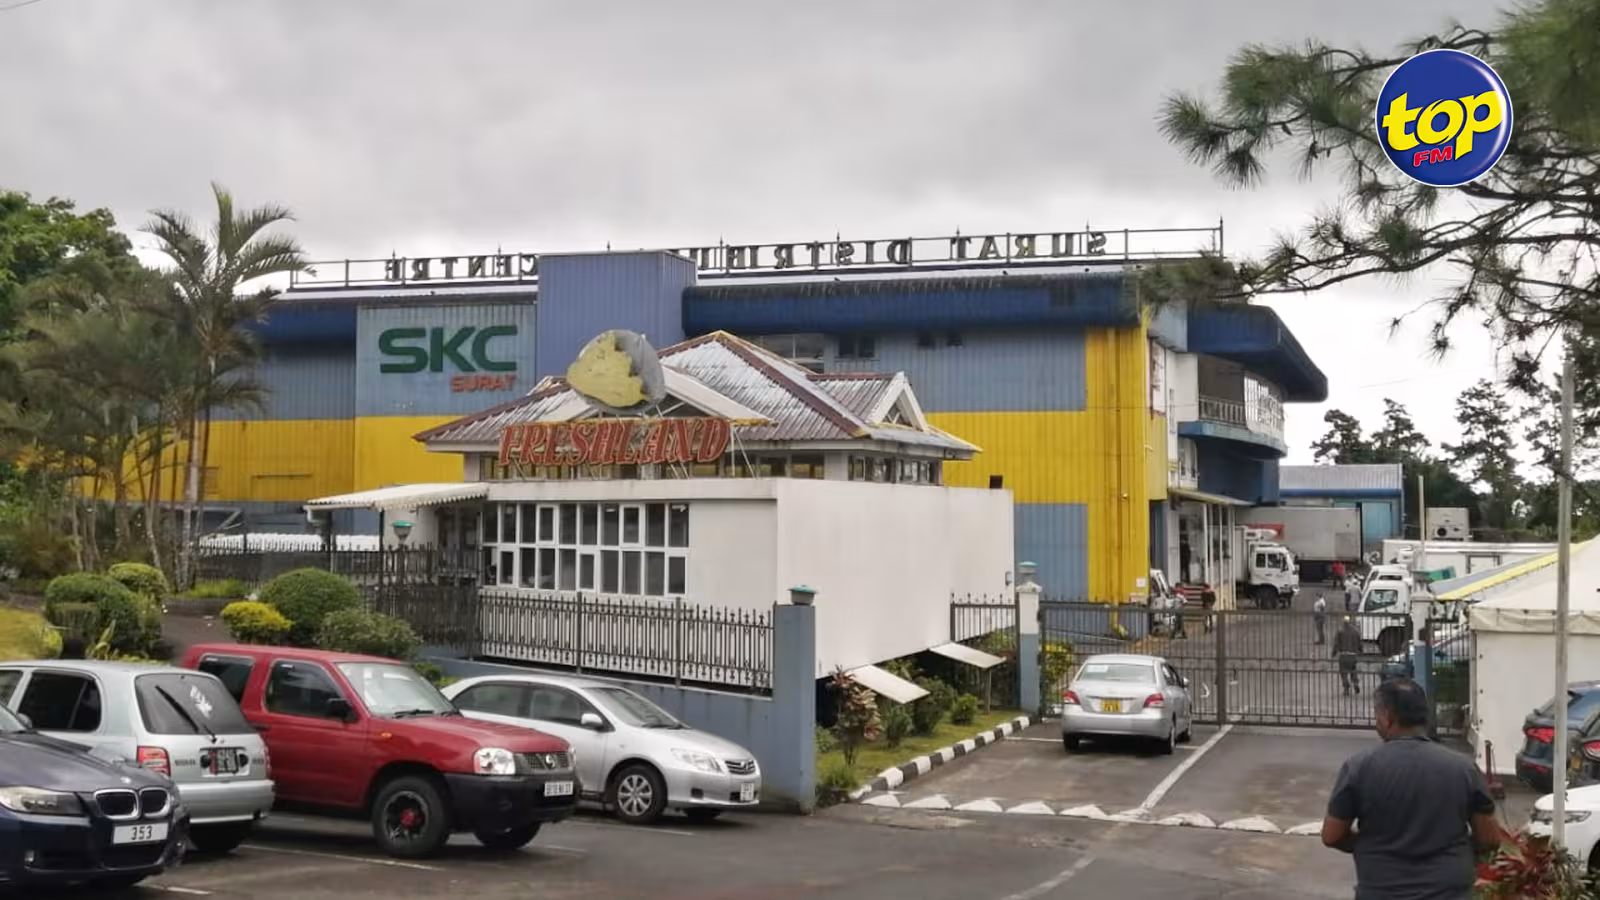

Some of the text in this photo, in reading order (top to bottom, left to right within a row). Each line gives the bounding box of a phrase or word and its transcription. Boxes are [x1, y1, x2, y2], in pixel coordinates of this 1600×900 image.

[378, 325, 519, 373] SKC
[450, 374, 517, 393] SURAT
[500, 418, 732, 467] FRESHLAND
[131, 826, 153, 841] 353
